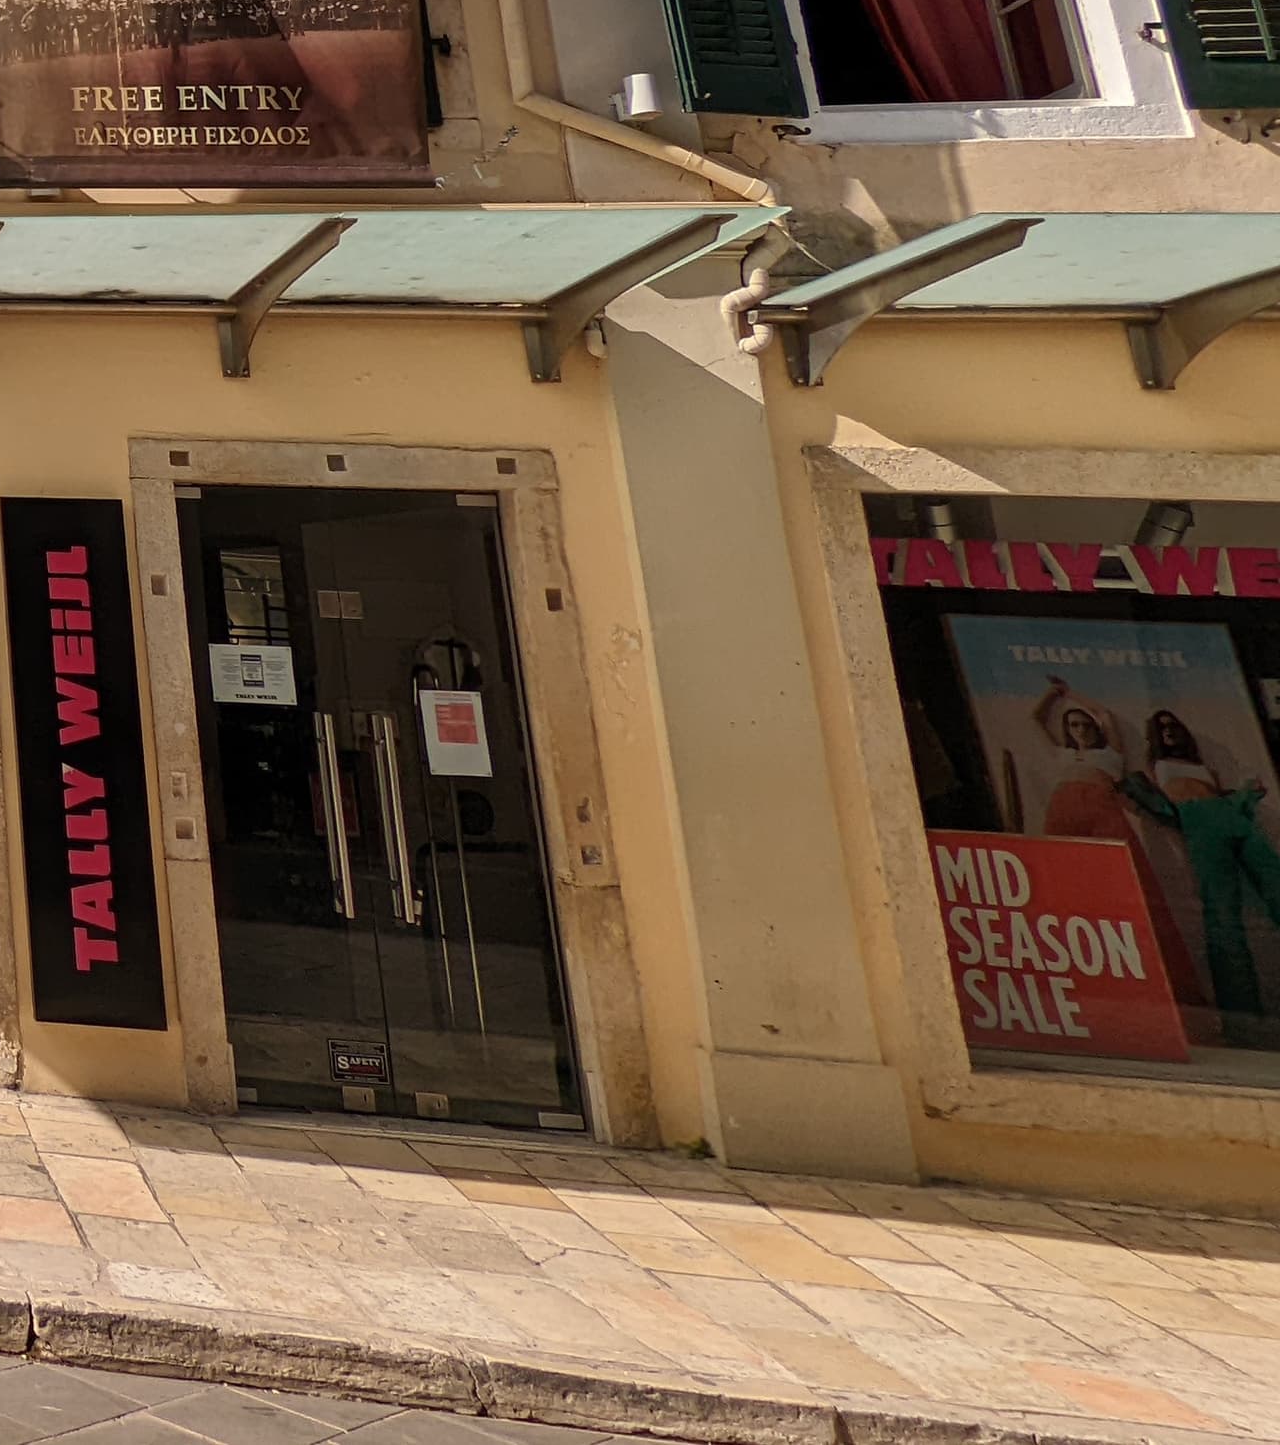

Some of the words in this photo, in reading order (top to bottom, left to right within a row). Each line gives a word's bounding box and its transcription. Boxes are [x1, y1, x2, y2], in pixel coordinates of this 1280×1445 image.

[71, 86, 163, 112] FREE
[176, 85, 303, 111] ENTRY
[74, 126, 198, 146] ΕΛΕΥΘΕΡΗ
[203, 126, 311, 146] ΕΙΣΟΔΟΣ
[61, 762, 119, 972] TALLY
[935, 845, 1030, 907] MID
[949, 906, 1146, 980] SEASON
[962, 969, 1090, 1038] SALE
